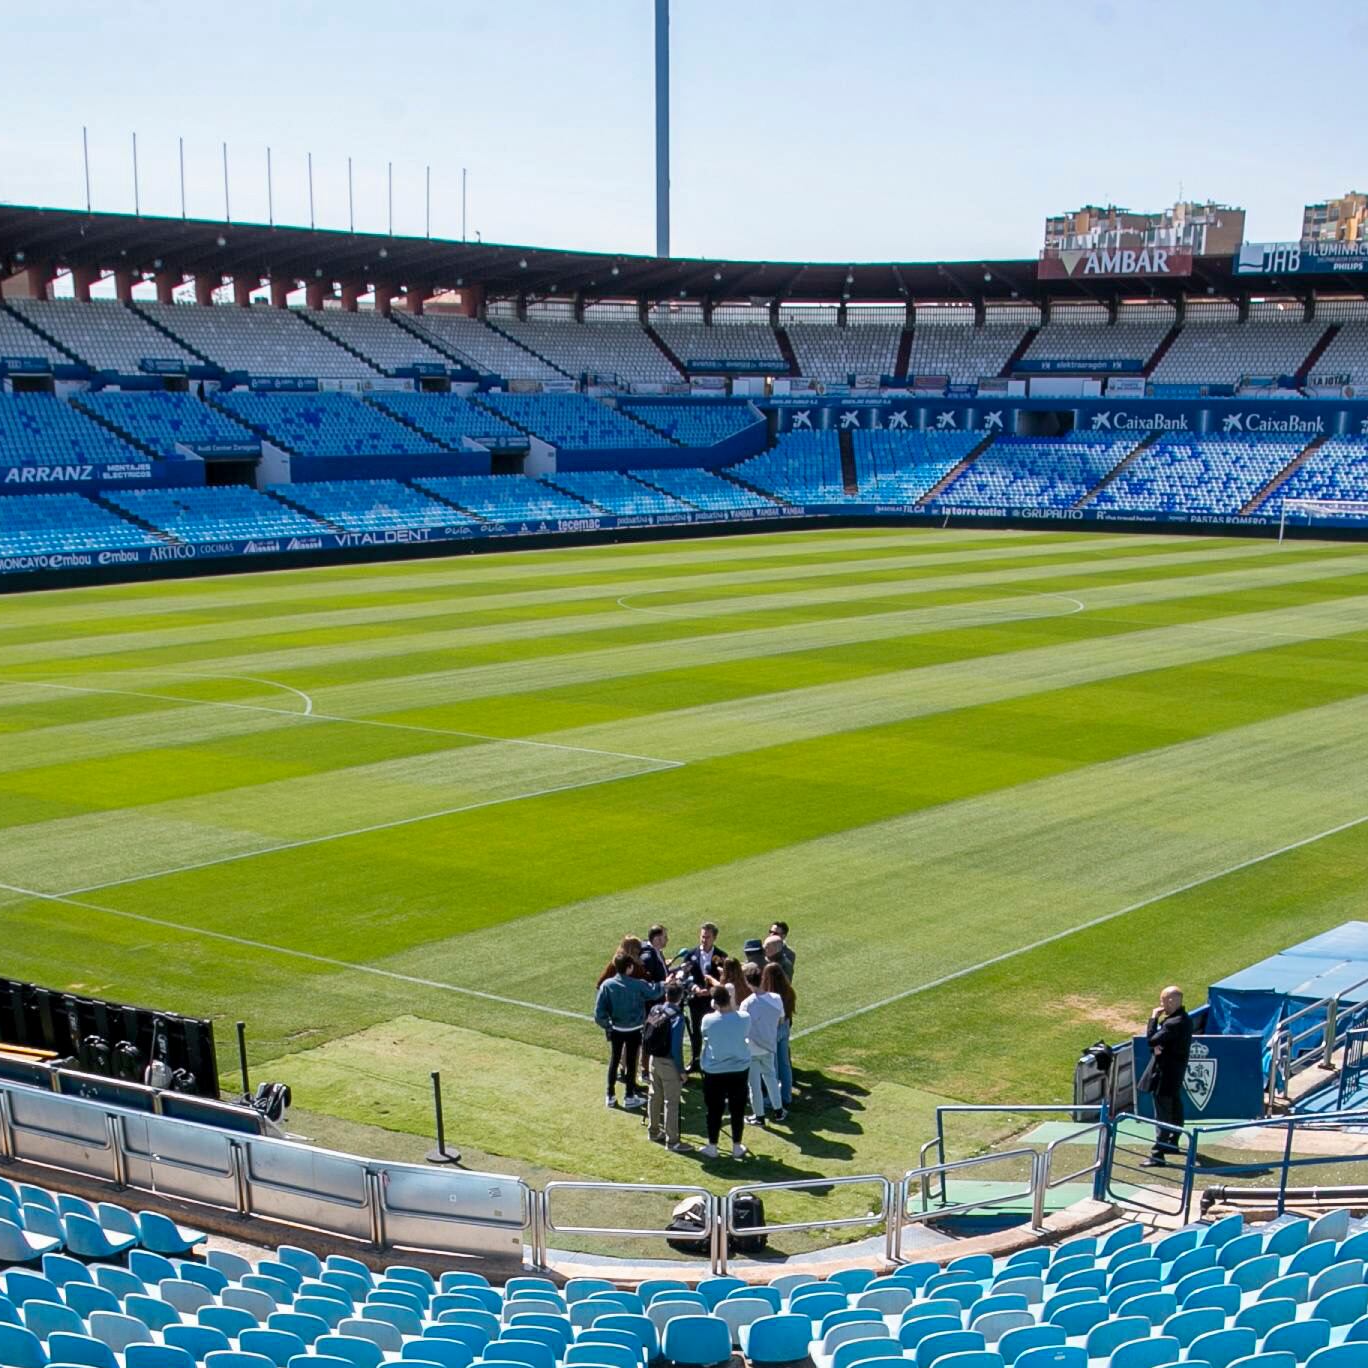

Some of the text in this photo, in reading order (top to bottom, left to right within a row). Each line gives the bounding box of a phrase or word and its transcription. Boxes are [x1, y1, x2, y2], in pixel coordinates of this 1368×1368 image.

[1084, 249, 1170, 274] AMBAR
[1334, 262, 1363, 271] PHILIPS
[1113, 411, 1188, 430] CaixaBank
[1245, 413, 1324, 433] CaixaBank
[4, 465, 93, 483] ARRANZ
[558, 518, 600, 532] tecemac
[1190, 515, 1225, 523] PASTAS
[334, 528, 431, 548] VITALDENT
[49, 554, 91, 568] embou
[98, 550, 139, 565] embou
[149, 544, 195, 561] ARTICO
[200, 543, 234, 554] COCINAS
